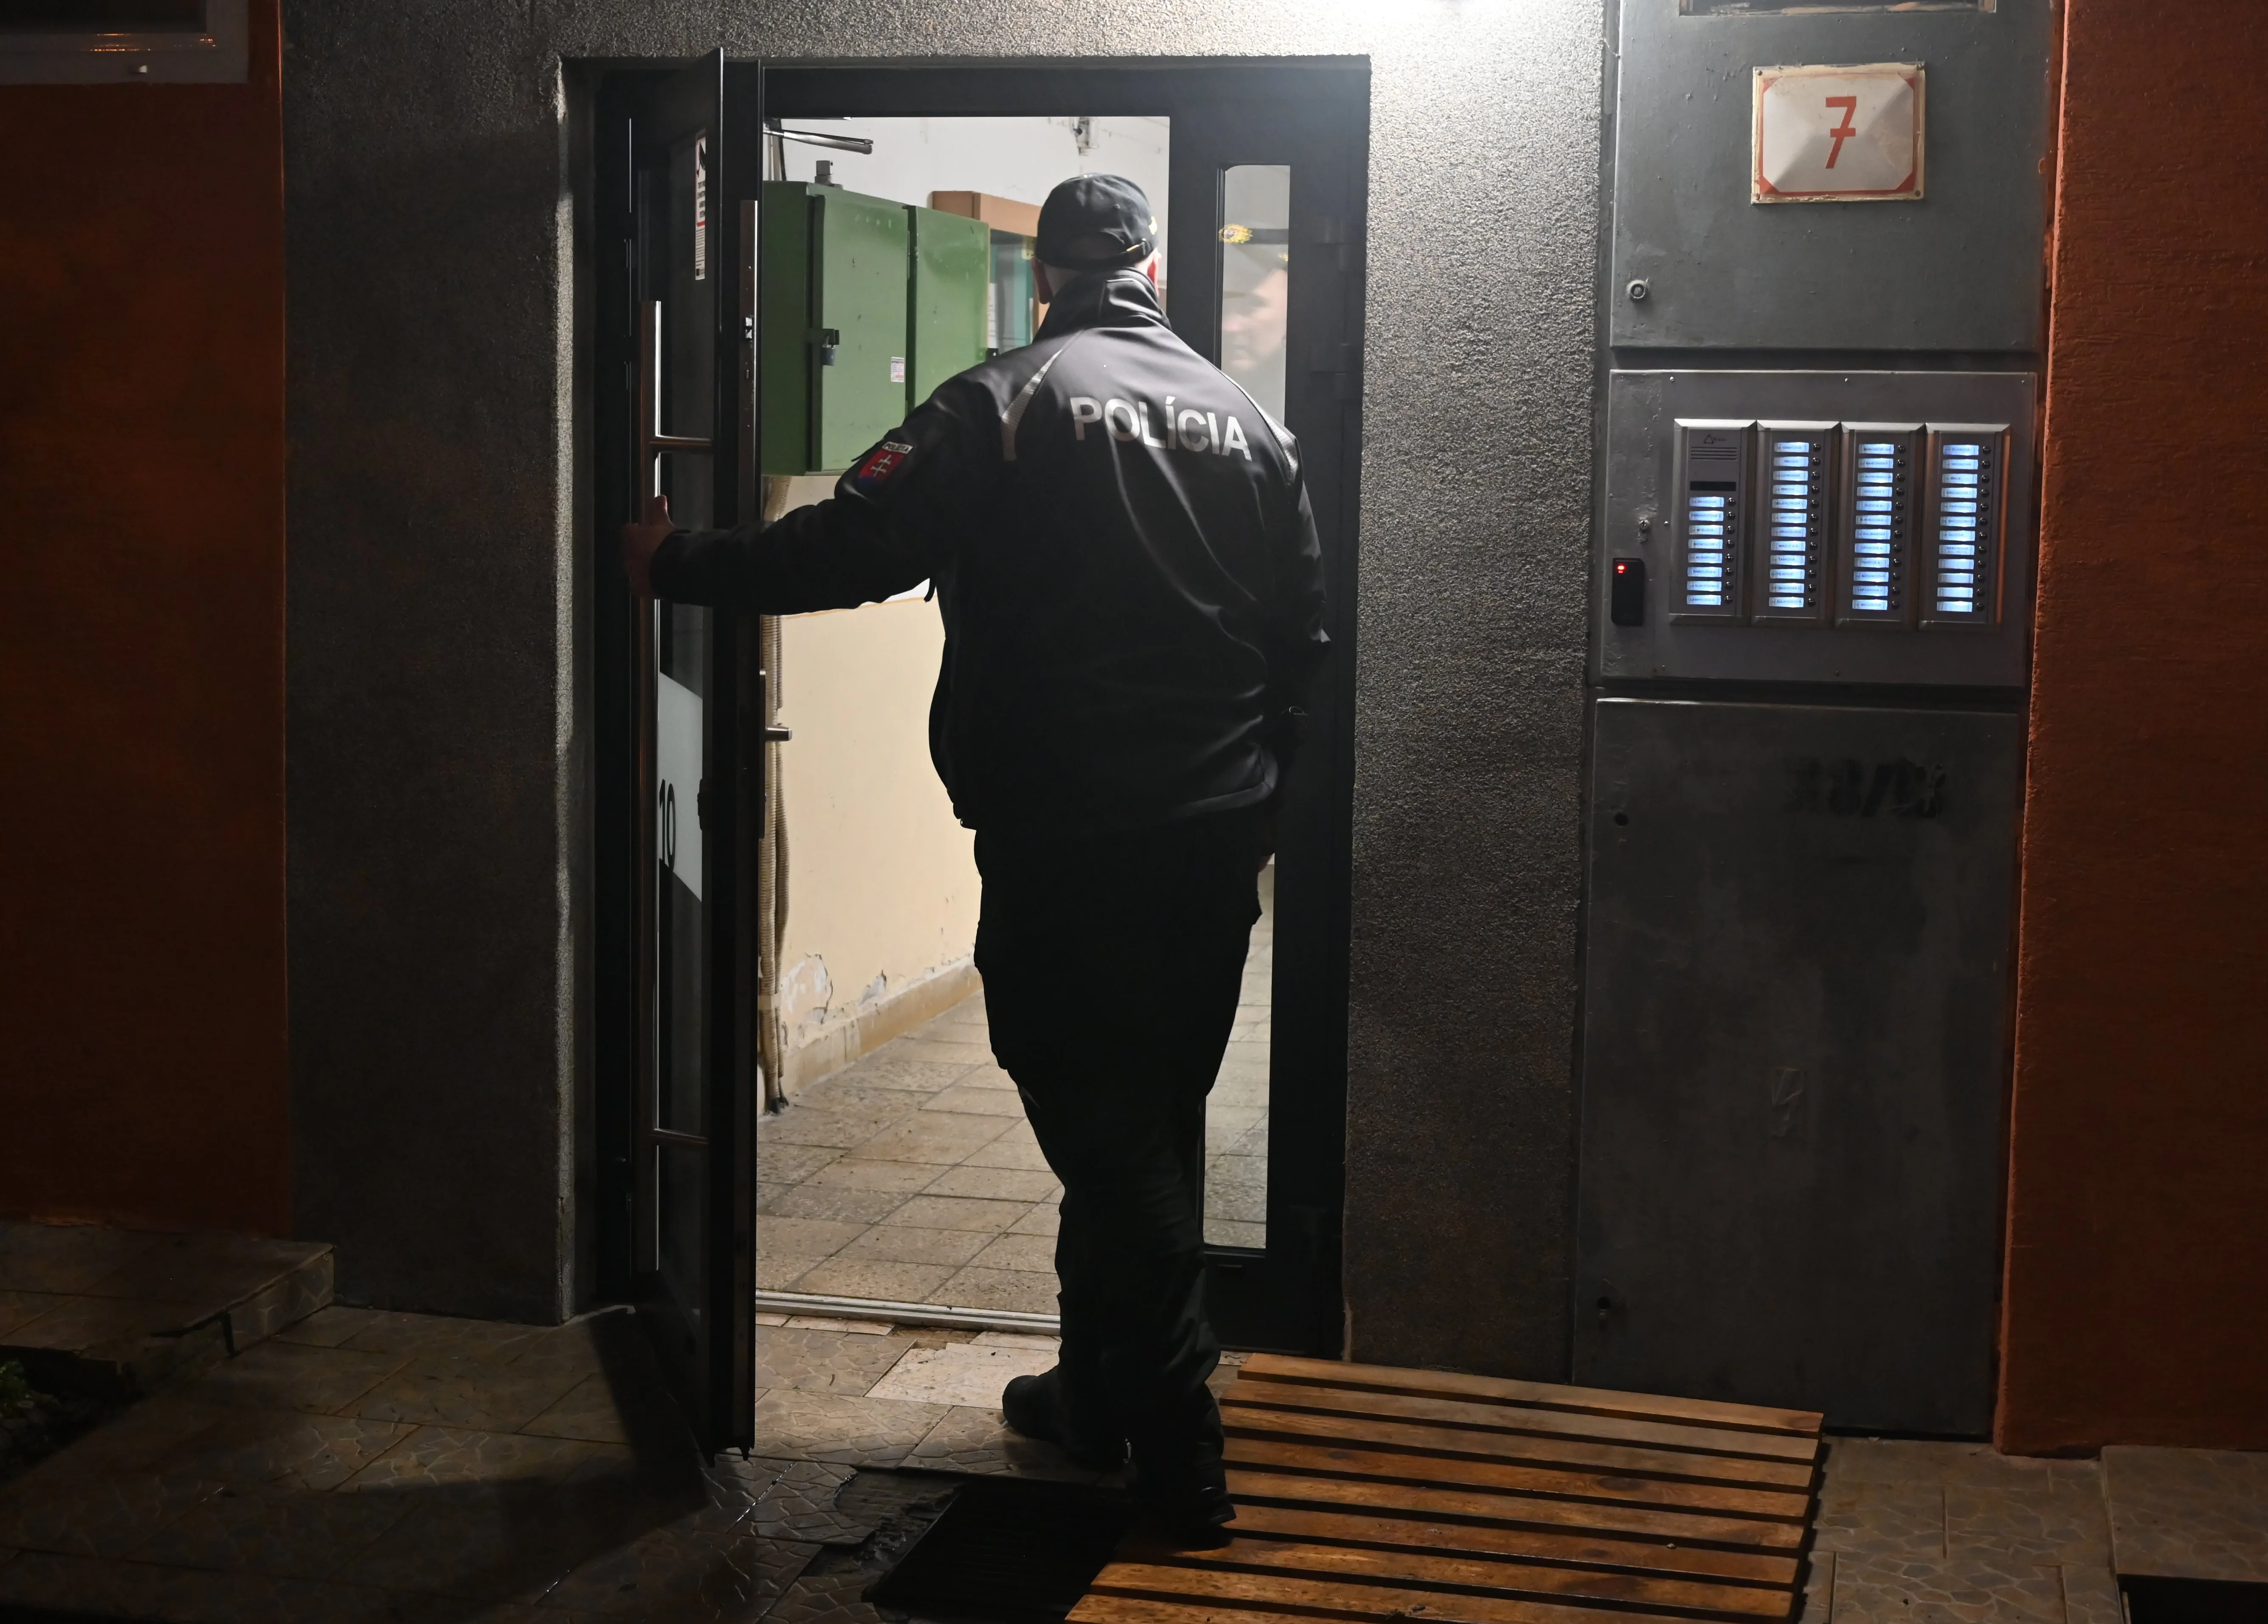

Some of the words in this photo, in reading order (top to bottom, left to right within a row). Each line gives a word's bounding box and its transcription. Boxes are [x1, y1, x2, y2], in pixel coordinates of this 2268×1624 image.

[1826, 96, 1857, 169] 7
[1070, 396, 1253, 462] POLÍCIA
[659, 779, 676, 872] 10
